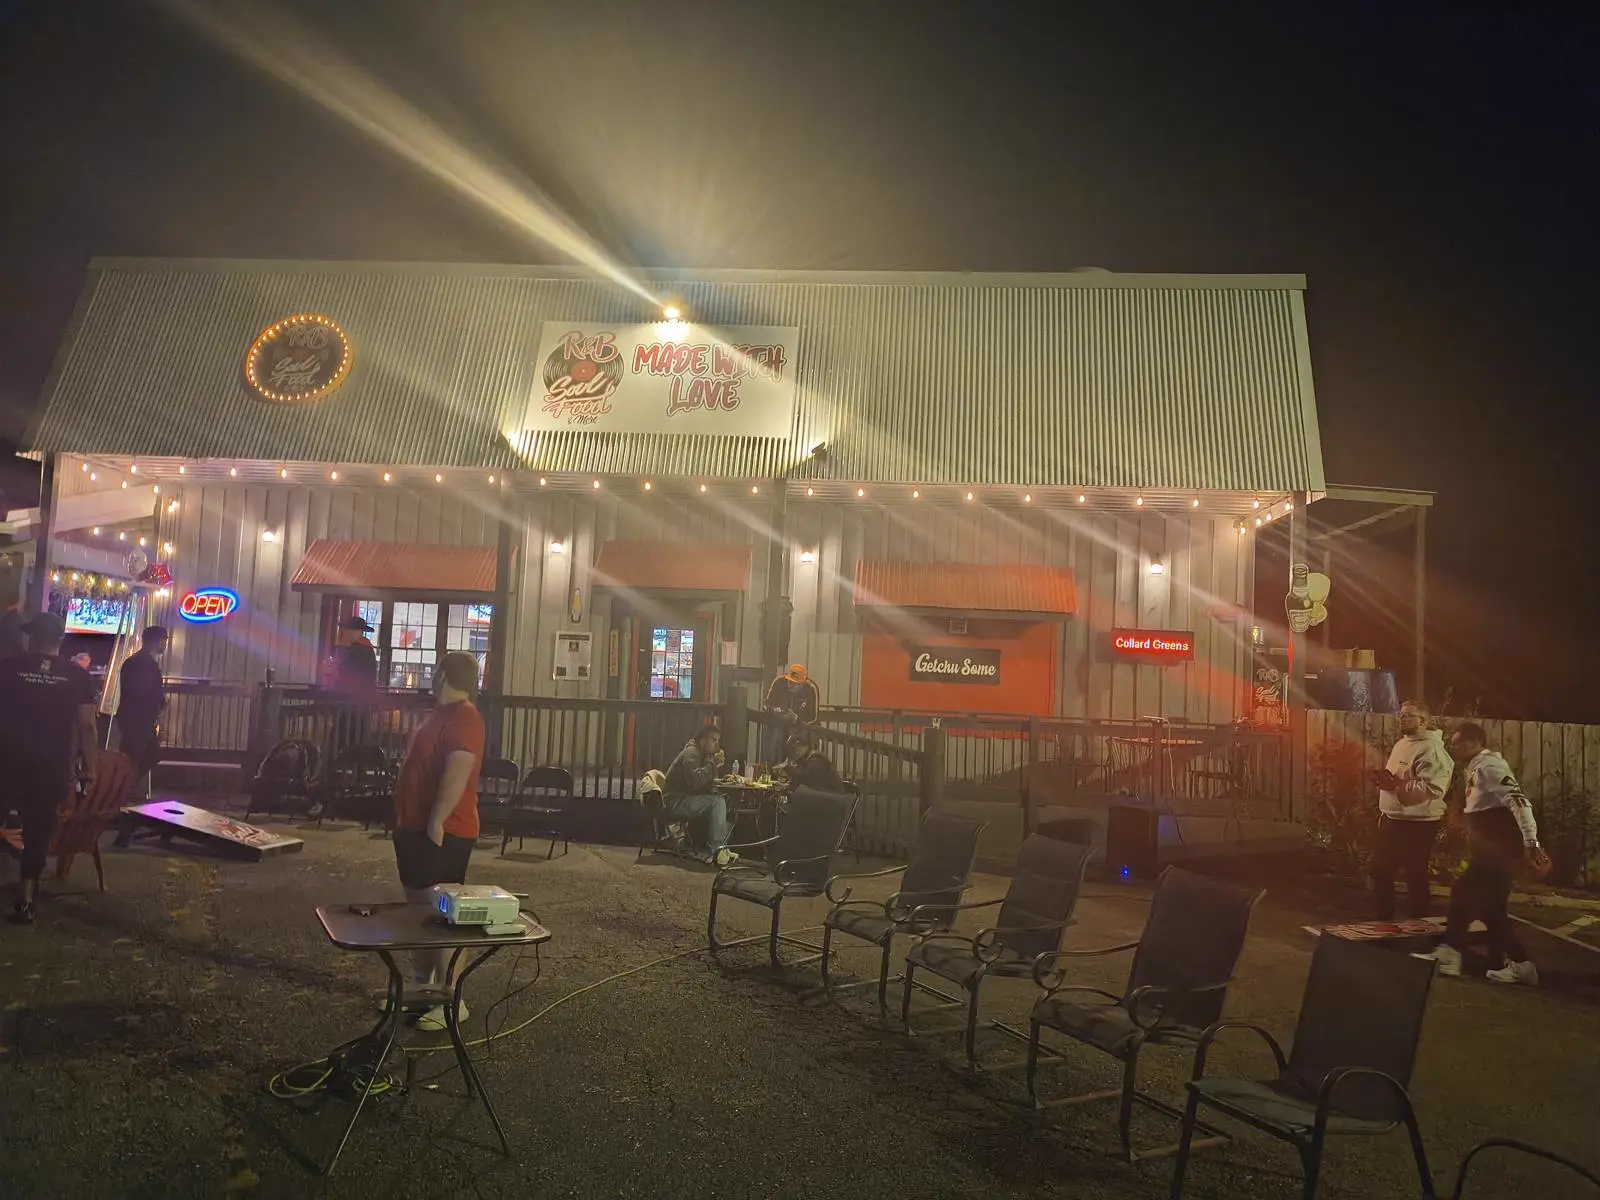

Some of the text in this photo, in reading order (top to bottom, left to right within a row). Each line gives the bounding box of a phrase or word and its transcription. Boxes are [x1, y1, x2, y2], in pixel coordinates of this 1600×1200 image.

[559, 331, 619, 363] R&B
[632, 342, 787, 382] MADE WITH
[543, 371, 608, 402] Soul
[667, 375, 742, 417] LOVE
[542, 390, 614, 418] Food
[182, 594, 232, 617] OPEN
[1115, 637, 1189, 651] Collard Greens
[915, 653, 997, 676] Getchu Some
